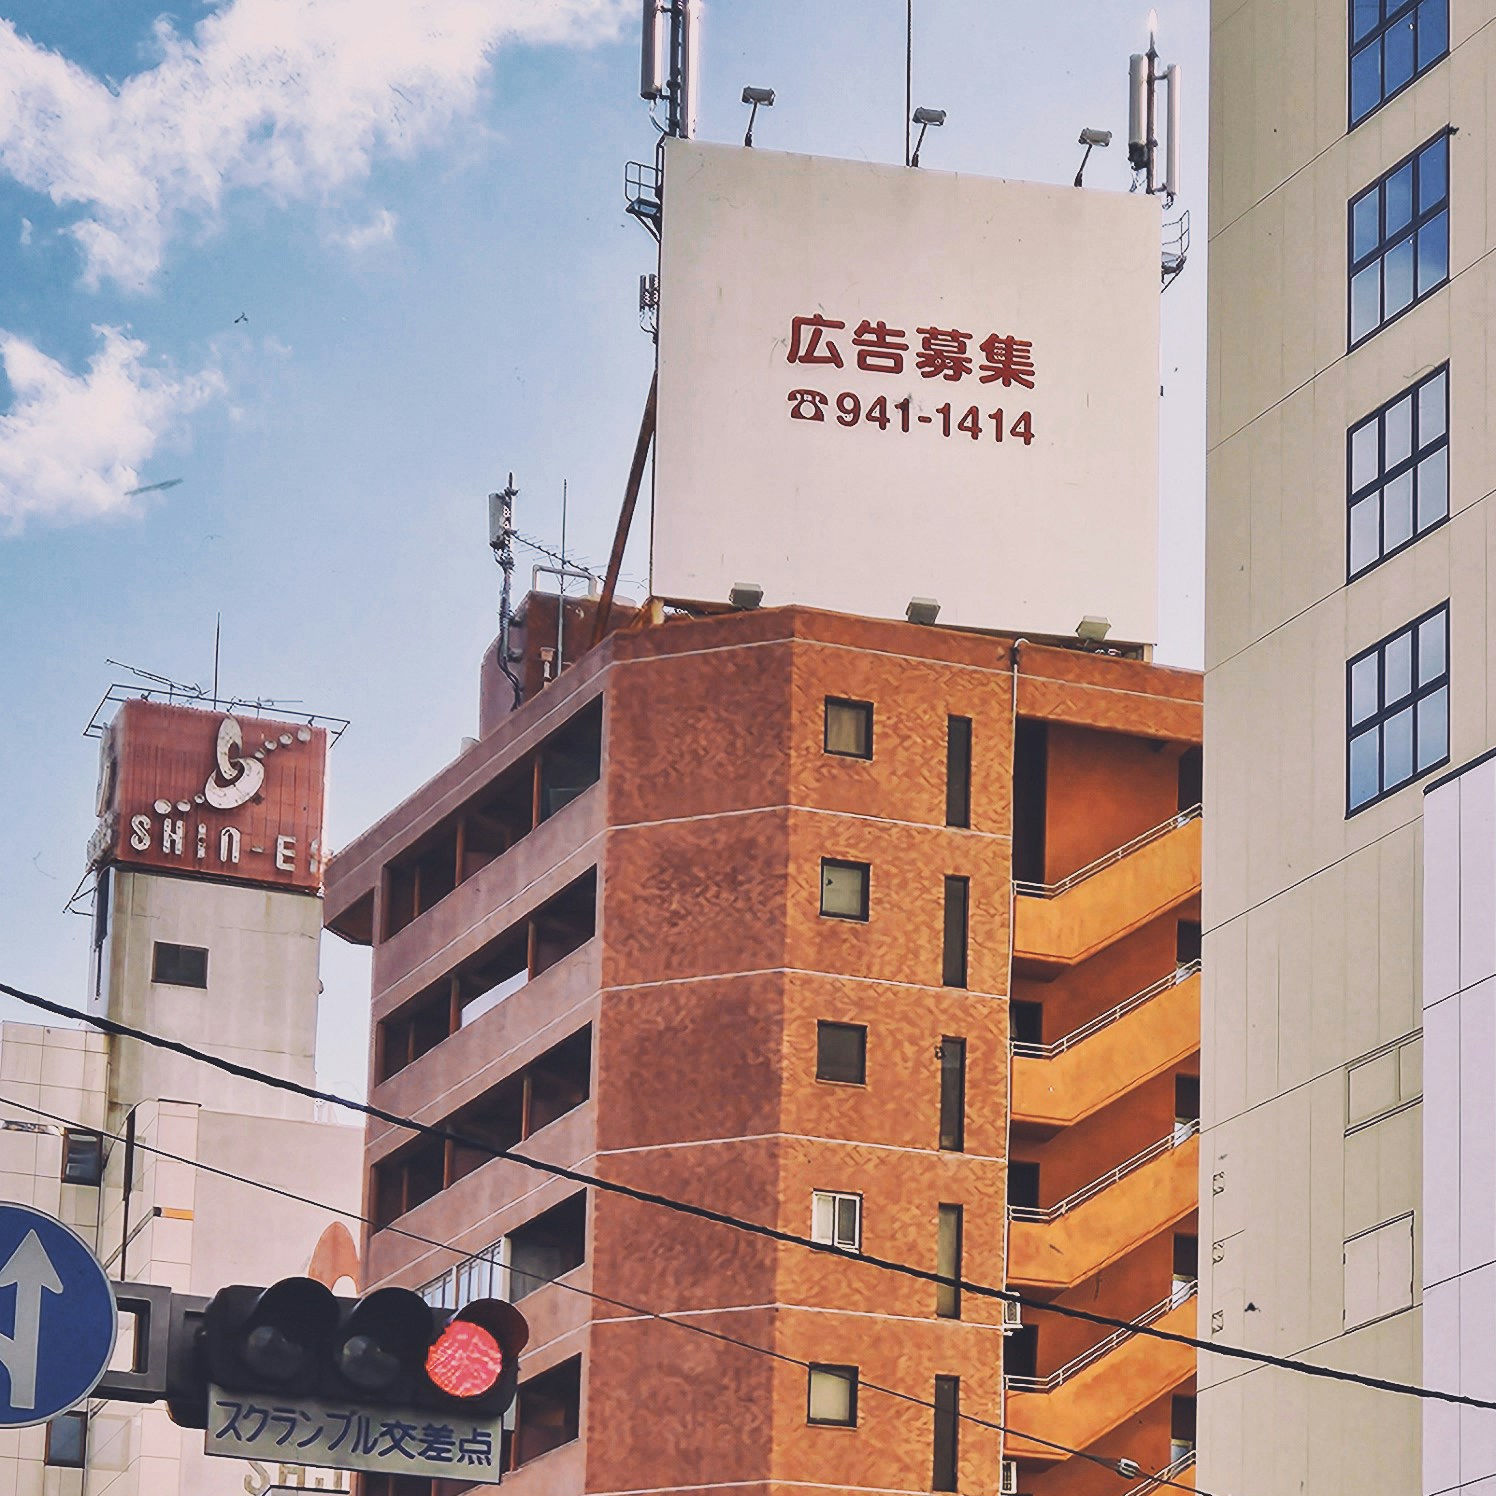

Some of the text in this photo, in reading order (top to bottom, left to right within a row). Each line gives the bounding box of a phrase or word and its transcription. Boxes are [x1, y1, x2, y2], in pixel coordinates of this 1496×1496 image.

[787, 313, 1035, 389] 広告募集
[836, 391, 1035, 446] 941-1414
[215, 1400, 494, 1467] スクランブル交差点
